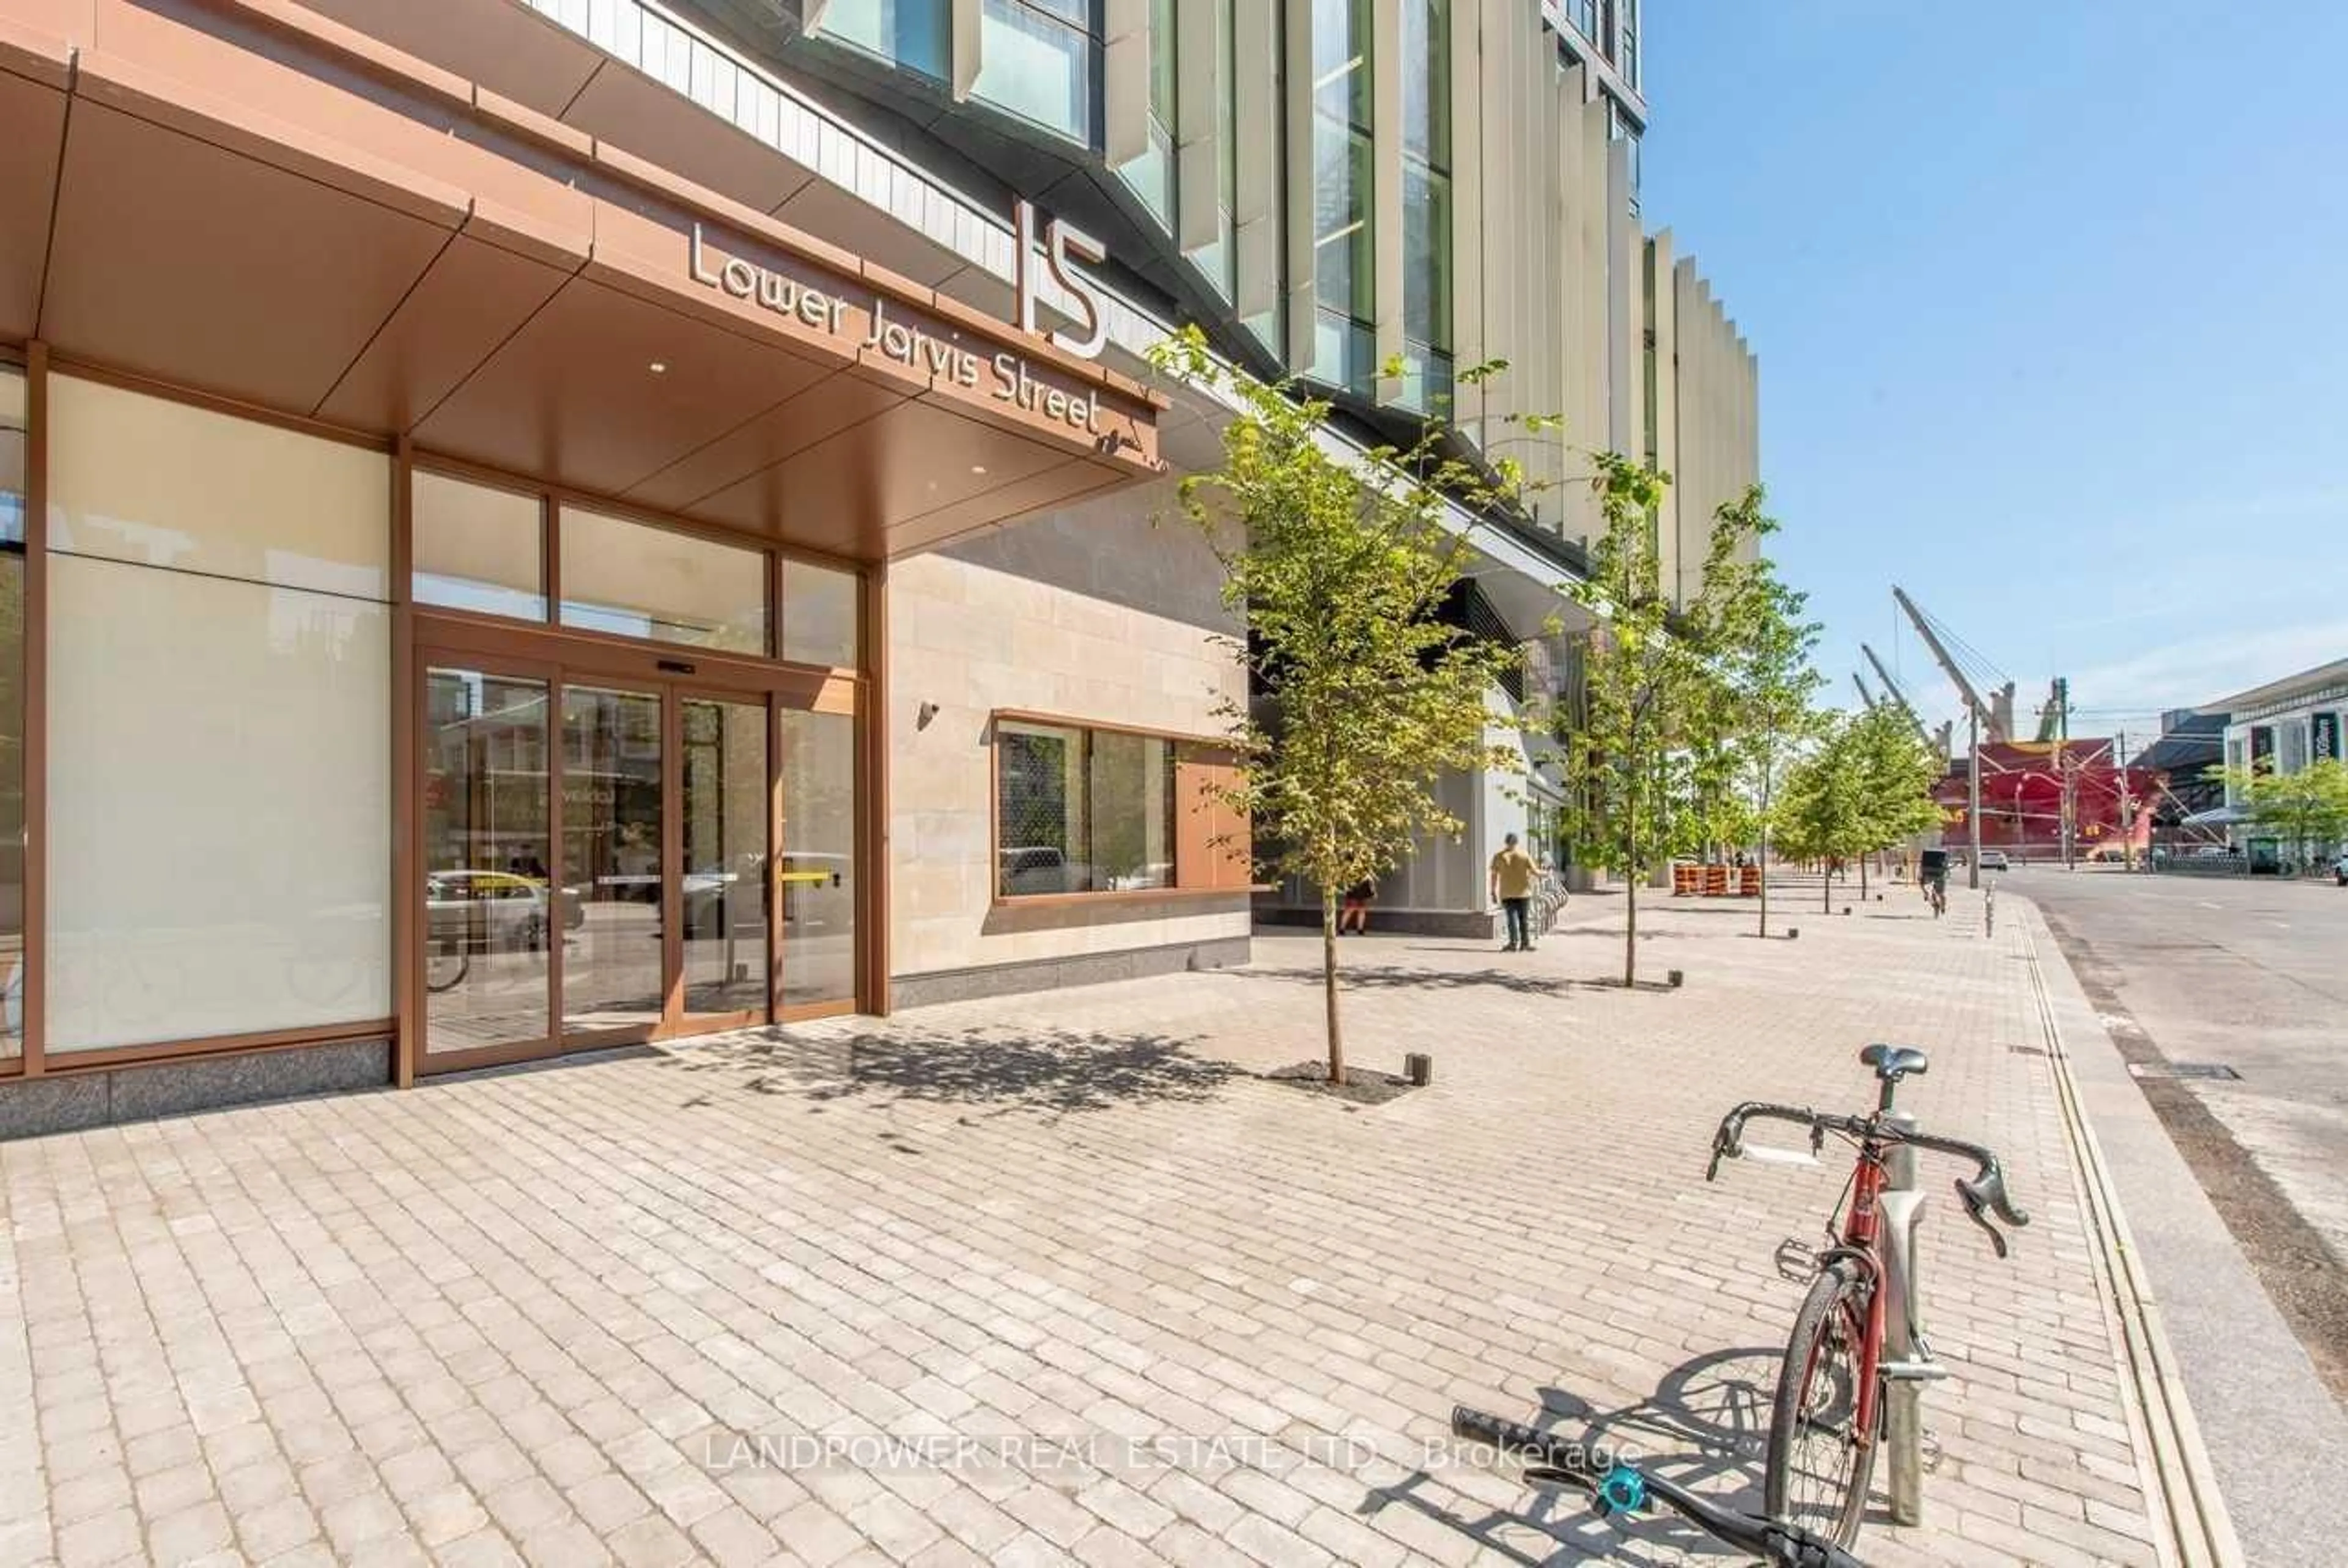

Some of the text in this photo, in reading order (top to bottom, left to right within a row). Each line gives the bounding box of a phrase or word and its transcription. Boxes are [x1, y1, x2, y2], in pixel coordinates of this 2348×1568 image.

[692, 222, 1101, 435] Lower Jarvis Street
[1016, 200, 1106, 358] 15
